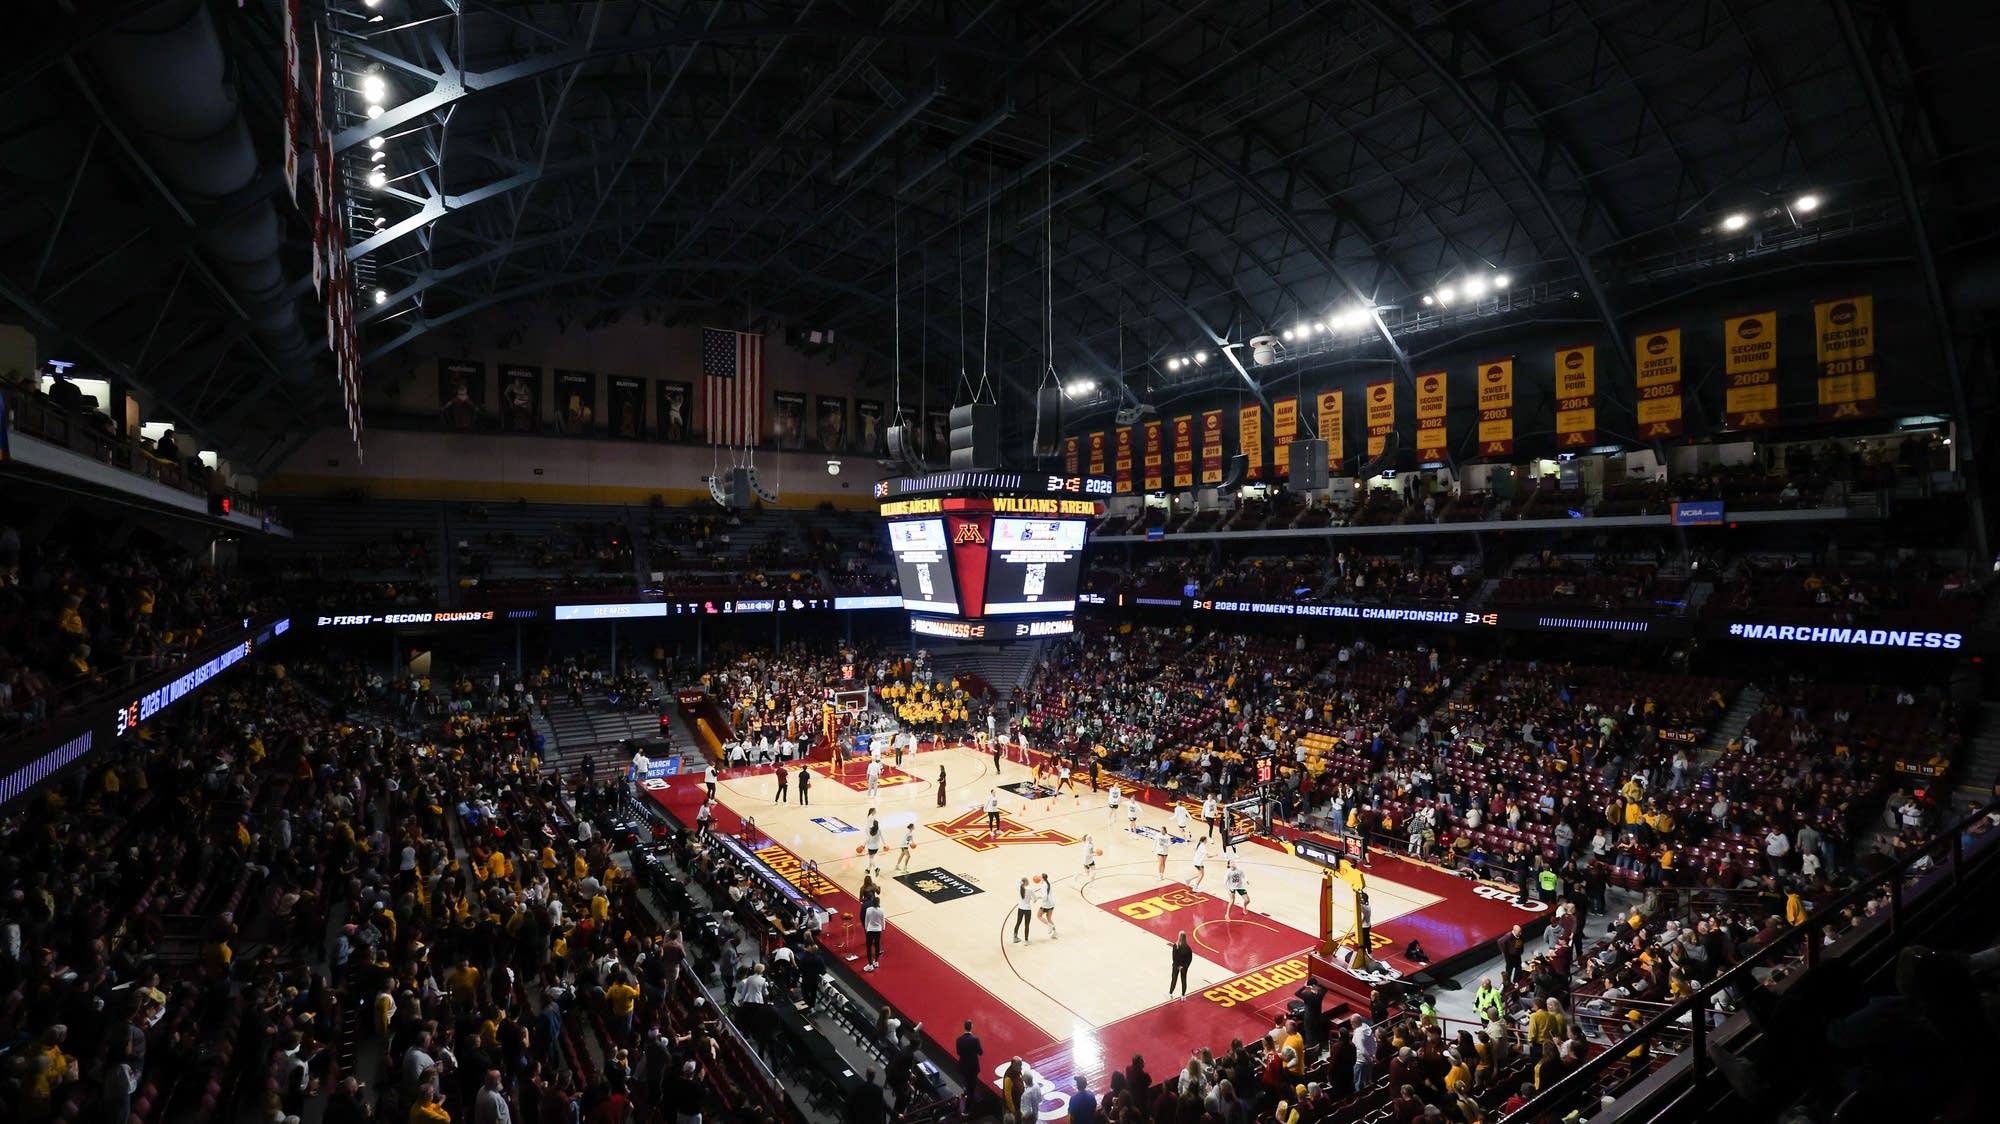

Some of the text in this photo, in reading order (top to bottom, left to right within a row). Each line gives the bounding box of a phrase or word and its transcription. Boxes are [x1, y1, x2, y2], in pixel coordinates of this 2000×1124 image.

[1823, 327, 1868, 342] SECOND
[1731, 341, 1772, 354] SECOND
[1826, 338, 1865, 352] ROUND
[1643, 356, 1674, 368] SWEET
[1734, 353, 1769, 364] ROUND
[1641, 366, 1677, 378] SIXTEEN
[1827, 359, 1865, 374] 2018
[1564, 373, 1586, 382] FINAL
[1734, 372, 1769, 385] 2009
[1484, 385, 1507, 394] SWEET
[1565, 381, 1586, 390] FOUR
[1644, 385, 1673, 398] 2005
[1420, 396, 1443, 404] SECOND
[1482, 392, 1510, 402] SIXTEEN
[1562, 398, 1588, 409] 2004
[1422, 403, 1442, 411] ROUND
[1484, 409, 1507, 420] 2003
[1422, 419, 1442, 428] 2002
[1085, 479, 1112, 493] 2026
[909, 499, 941, 513] ARENA
[993, 498, 1095, 514] WILLIAMS ARENA
[954, 524, 985, 543] M
[593, 607, 630, 615] OLE MISS
[1215, 602, 1458, 622] 2026 DI WOMEN'S BASKETBALL CHAMPIONSHIP
[333, 615, 371, 625] FIRST
[385, 613, 432, 623] SECOND
[434, 612, 482, 622] ROUNDS
[1730, 623, 1962, 649] #MARCHMADNESS
[141, 690, 160, 720] 2026
[170, 671, 194, 702] WOMEN'S
[648, 760, 670, 769] MARCH
[1258, 767, 1271, 782] 30
[1349, 845, 1361, 856] 30
[928, 869, 974, 894] CAMBRIA
[1203, 958, 1308, 1008] GOPHERS
